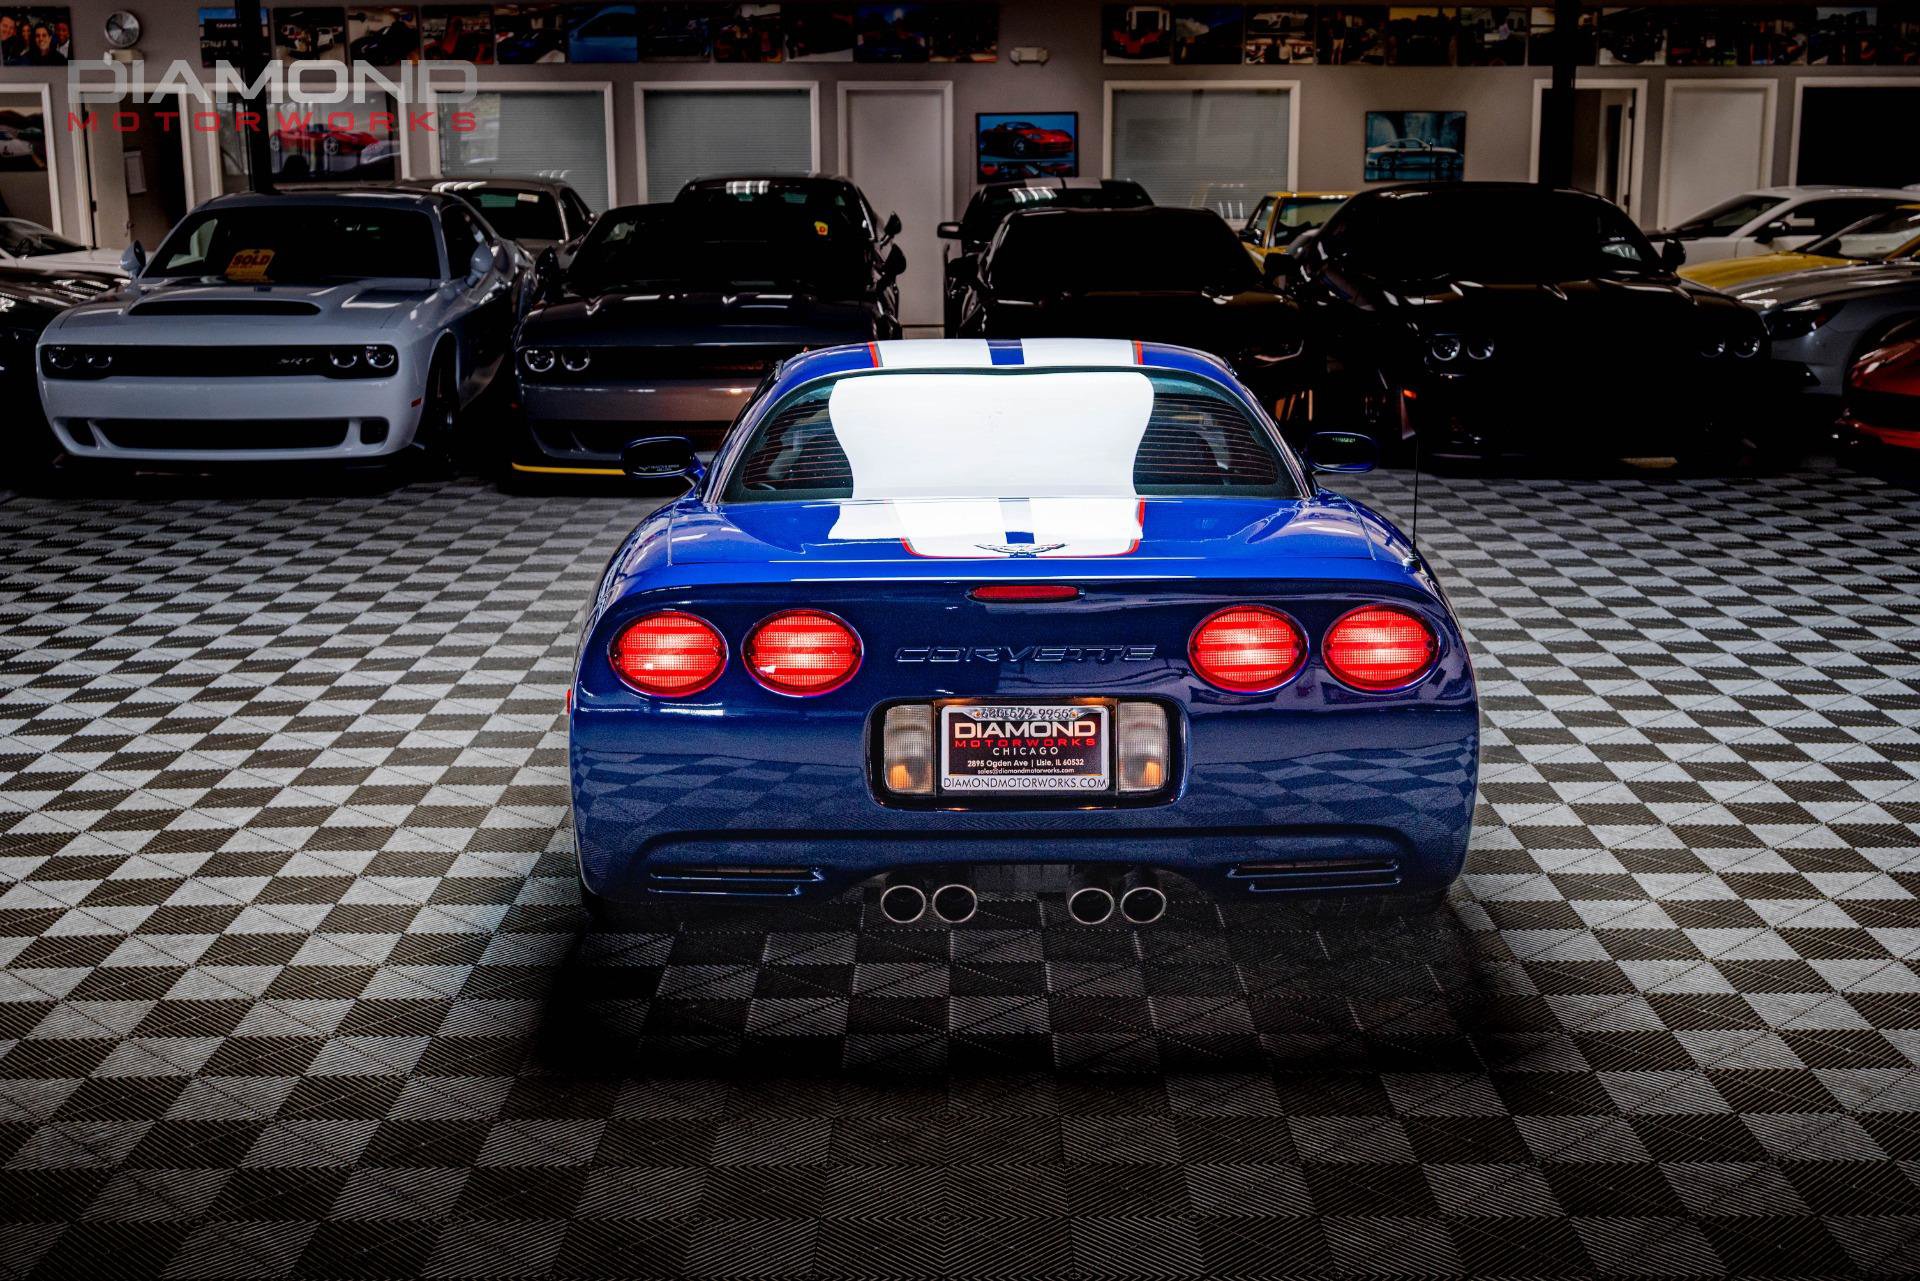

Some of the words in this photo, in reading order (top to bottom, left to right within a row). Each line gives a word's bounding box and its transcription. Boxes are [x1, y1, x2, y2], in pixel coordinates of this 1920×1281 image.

[232, 254, 270, 265] SOLD
[894, 644, 1158, 664] CORVETTE
[954, 720, 1096, 738] DIAMOND
[954, 738, 1096, 748] MOTORWORKS
[992, 746, 1059, 756] CHICAGO
[967, 760, 985, 768] 2895
[986, 759, 1012, 768] Ogden
[1062, 758, 1084, 766] 60532
[977, 767, 1075, 775] sales@diamondmotorworks.com
[943, 777, 1107, 789] DIAMONDMOTORWORKS.COM
